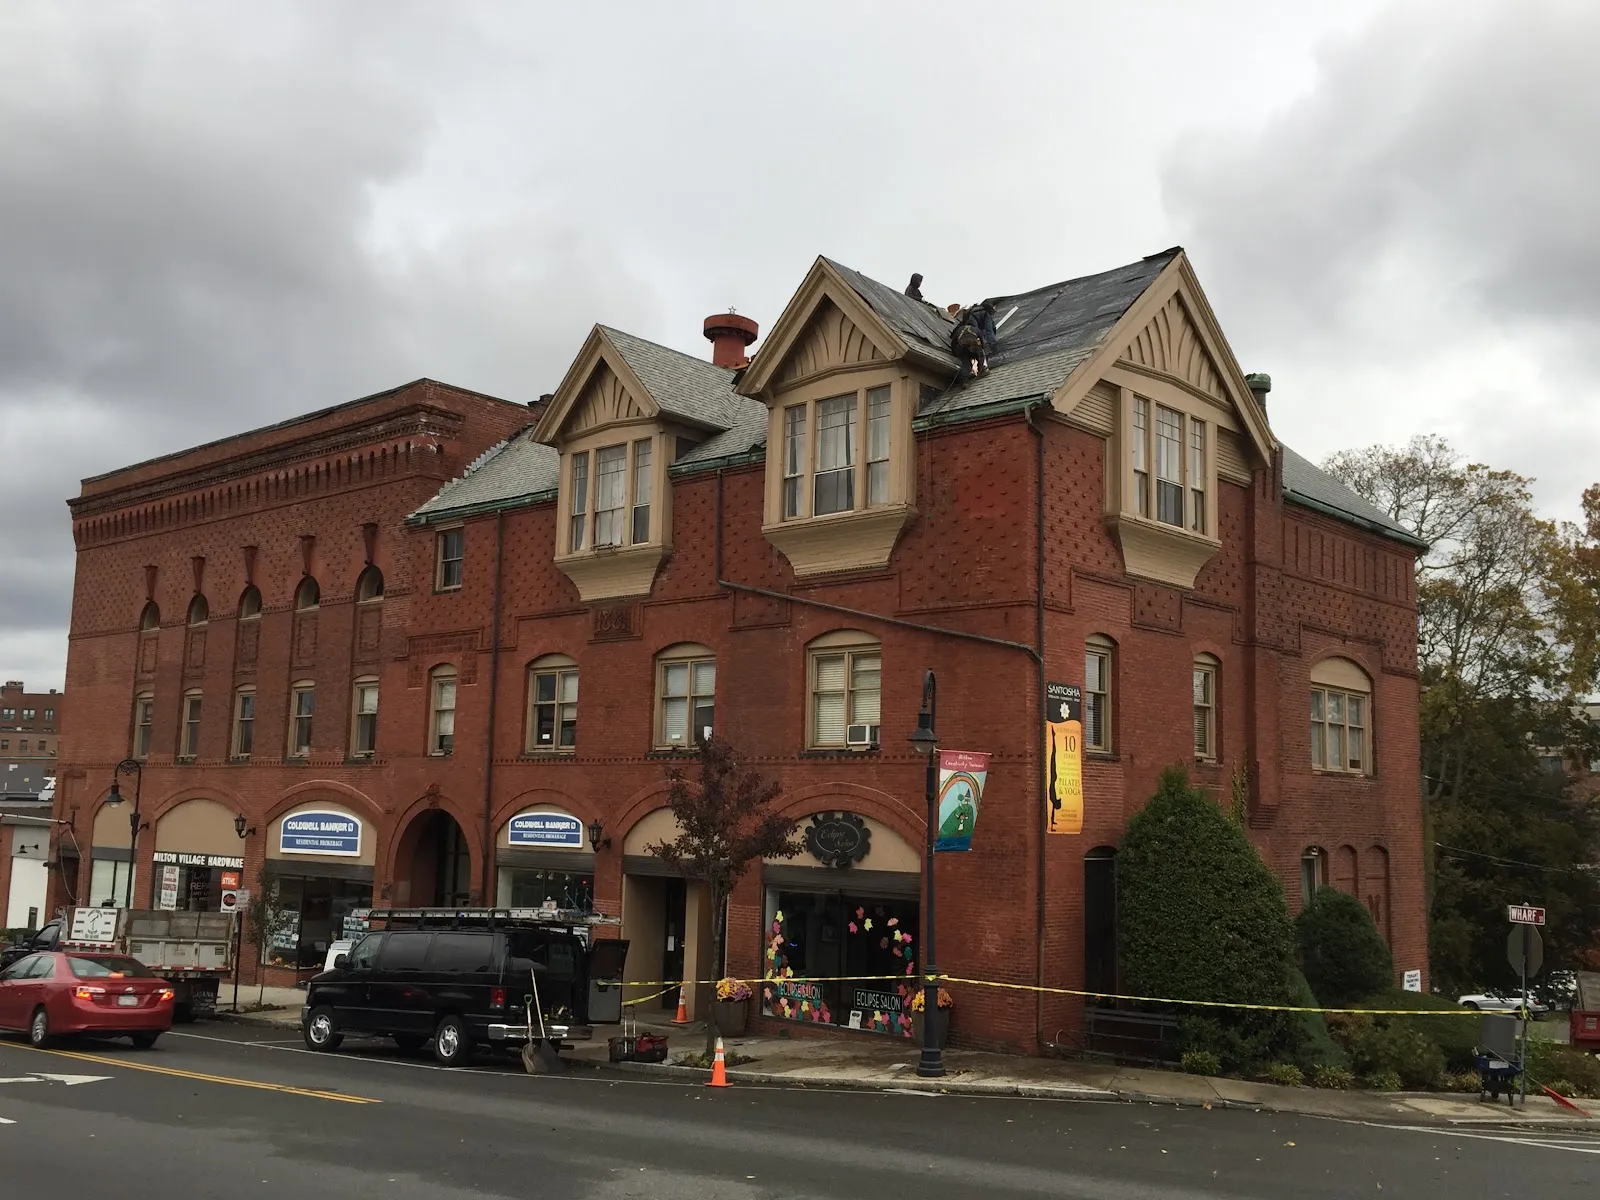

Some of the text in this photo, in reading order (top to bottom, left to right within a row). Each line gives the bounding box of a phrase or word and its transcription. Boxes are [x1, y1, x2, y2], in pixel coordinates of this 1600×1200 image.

[1048, 684, 1080, 697] SANTOSHA
[1064, 735, 1076, 752] 10
[1058, 778, 1080, 787] PILATES
[153, 852, 244, 868] MILTON VILLAGE HARDWARE
[1511, 907, 1537, 922] WHARF
[780, 981, 801, 998] ECLIPSE
[856, 991, 901, 1010] ECLIPSE SALON
